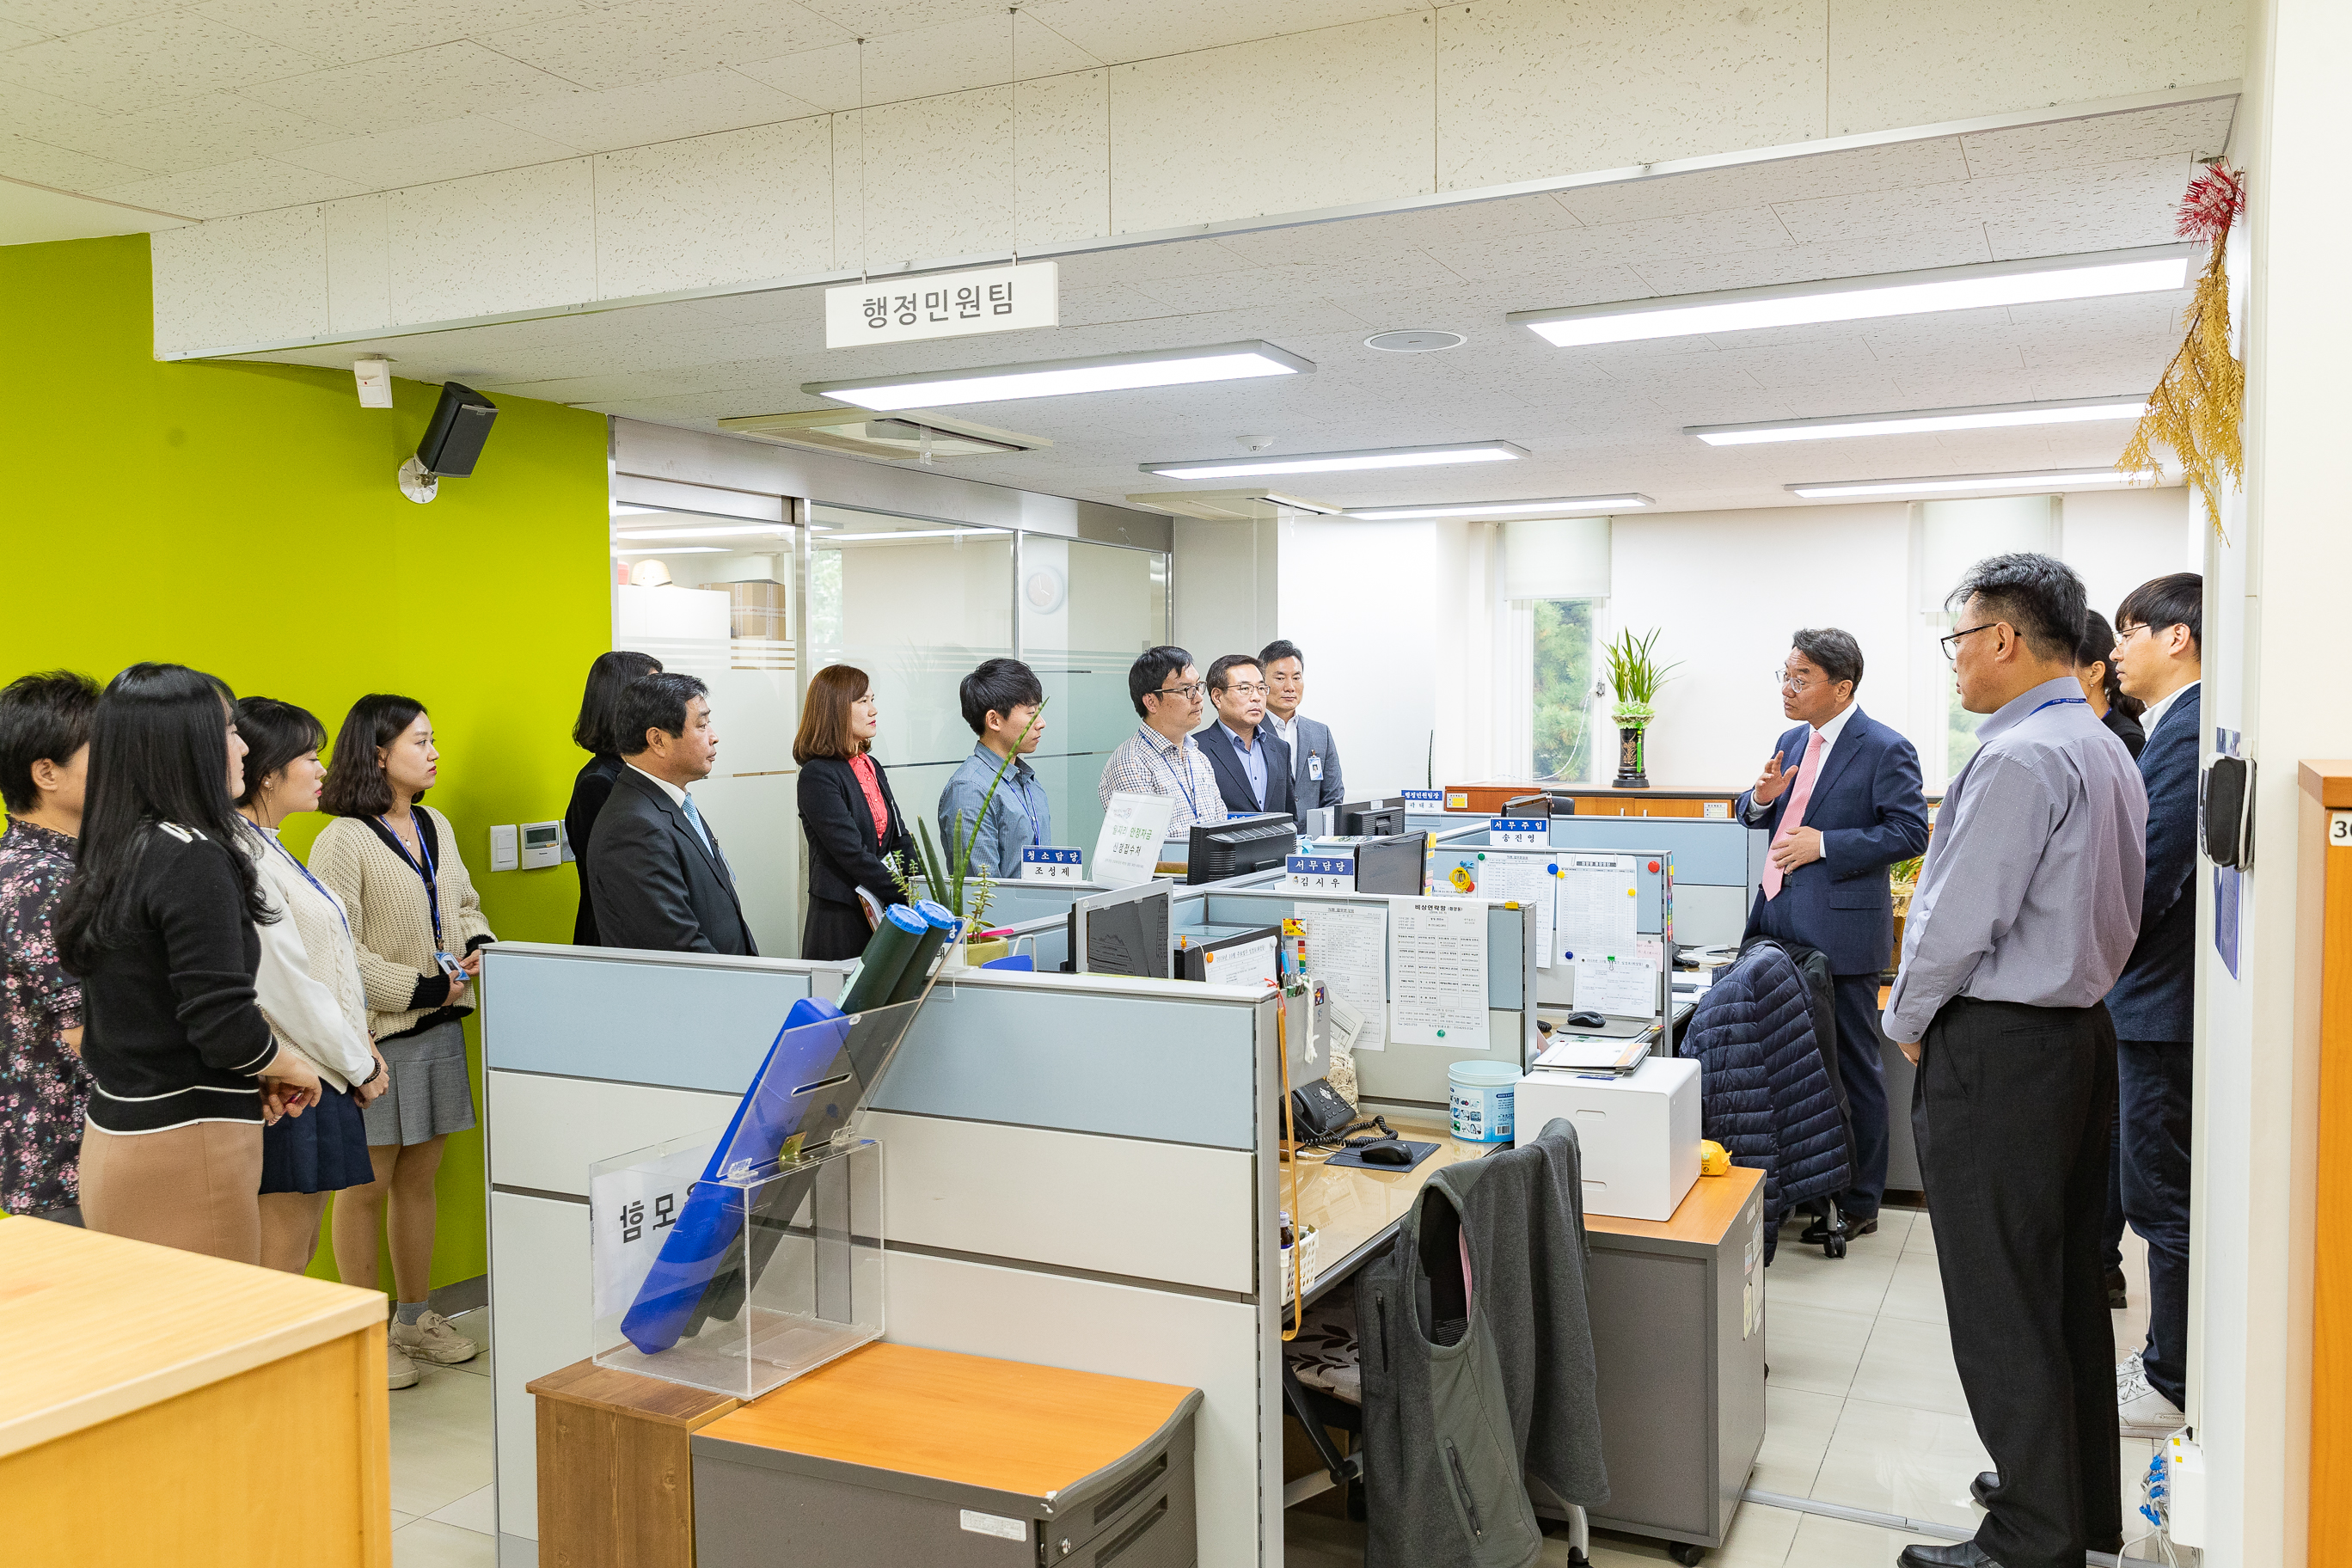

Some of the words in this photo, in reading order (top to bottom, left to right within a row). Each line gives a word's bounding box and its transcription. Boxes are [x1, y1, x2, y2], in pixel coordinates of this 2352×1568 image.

[862, 281, 1013, 329] 행정민원팀
[1494, 820, 1542, 830] 서무주임
[2334, 820, 2352, 838] 3
[1130, 827, 1153, 841] 안정자금
[1502, 833, 1534, 843] 송진영
[1112, 842, 1142, 856] 신청접수처
[1027, 850, 1079, 862] 청소담당
[1035, 866, 1069, 877] 조성제
[1295, 860, 1345, 873] 서무담당
[1301, 877, 1340, 888] 김시우
